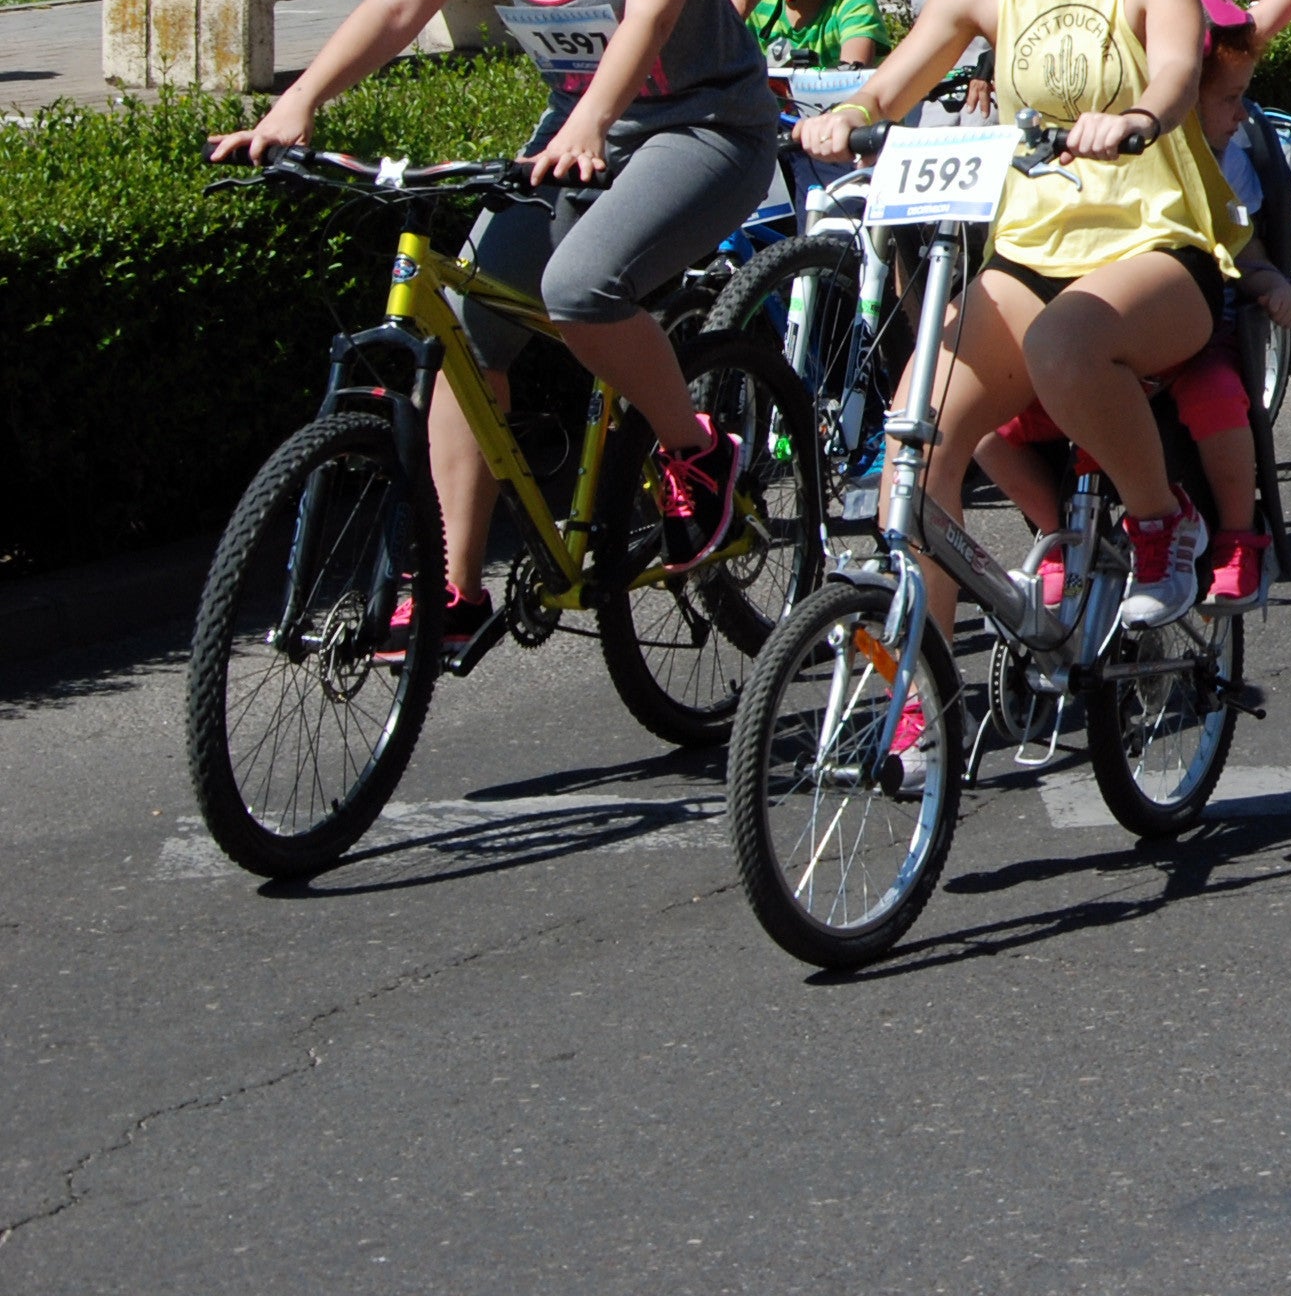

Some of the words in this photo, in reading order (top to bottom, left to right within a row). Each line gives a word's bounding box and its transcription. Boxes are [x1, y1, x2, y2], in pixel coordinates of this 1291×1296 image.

[1017, 21, 1052, 71] DON'T
[1053, 13, 1105, 39] TOUCH
[898, 156, 983, 194] 1593
